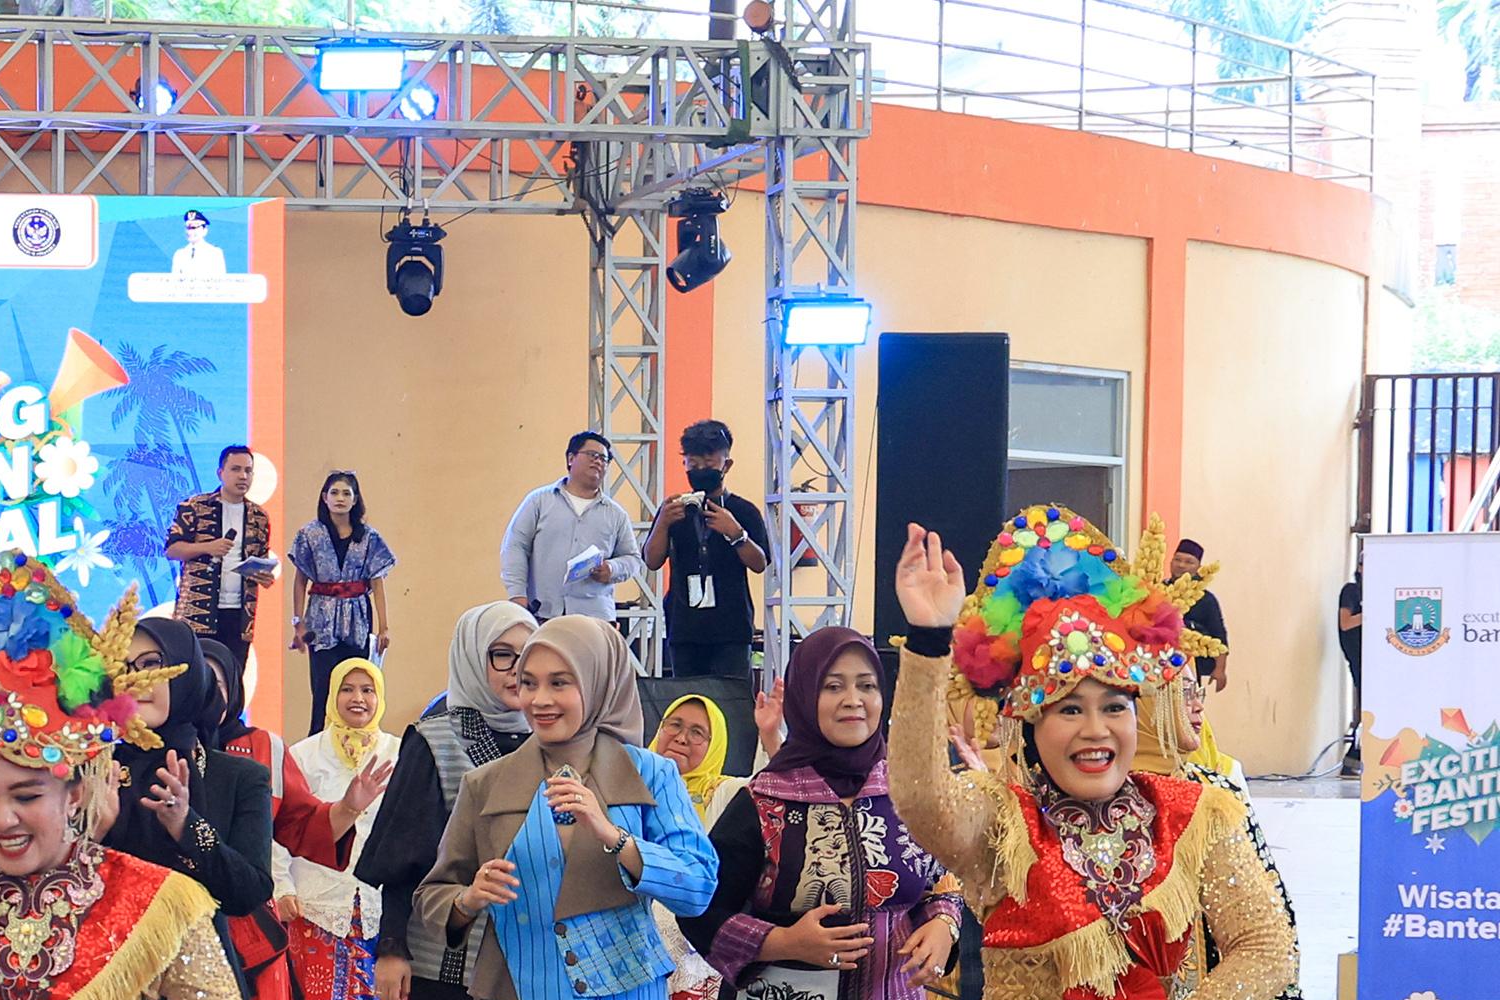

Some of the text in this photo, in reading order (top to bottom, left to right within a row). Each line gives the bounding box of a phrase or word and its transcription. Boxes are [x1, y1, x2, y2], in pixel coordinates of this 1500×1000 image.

[1414, 771, 1500, 809] BANT
[1397, 883, 1500, 911] Wisata
[1382, 912, 1500, 940] #Bante
